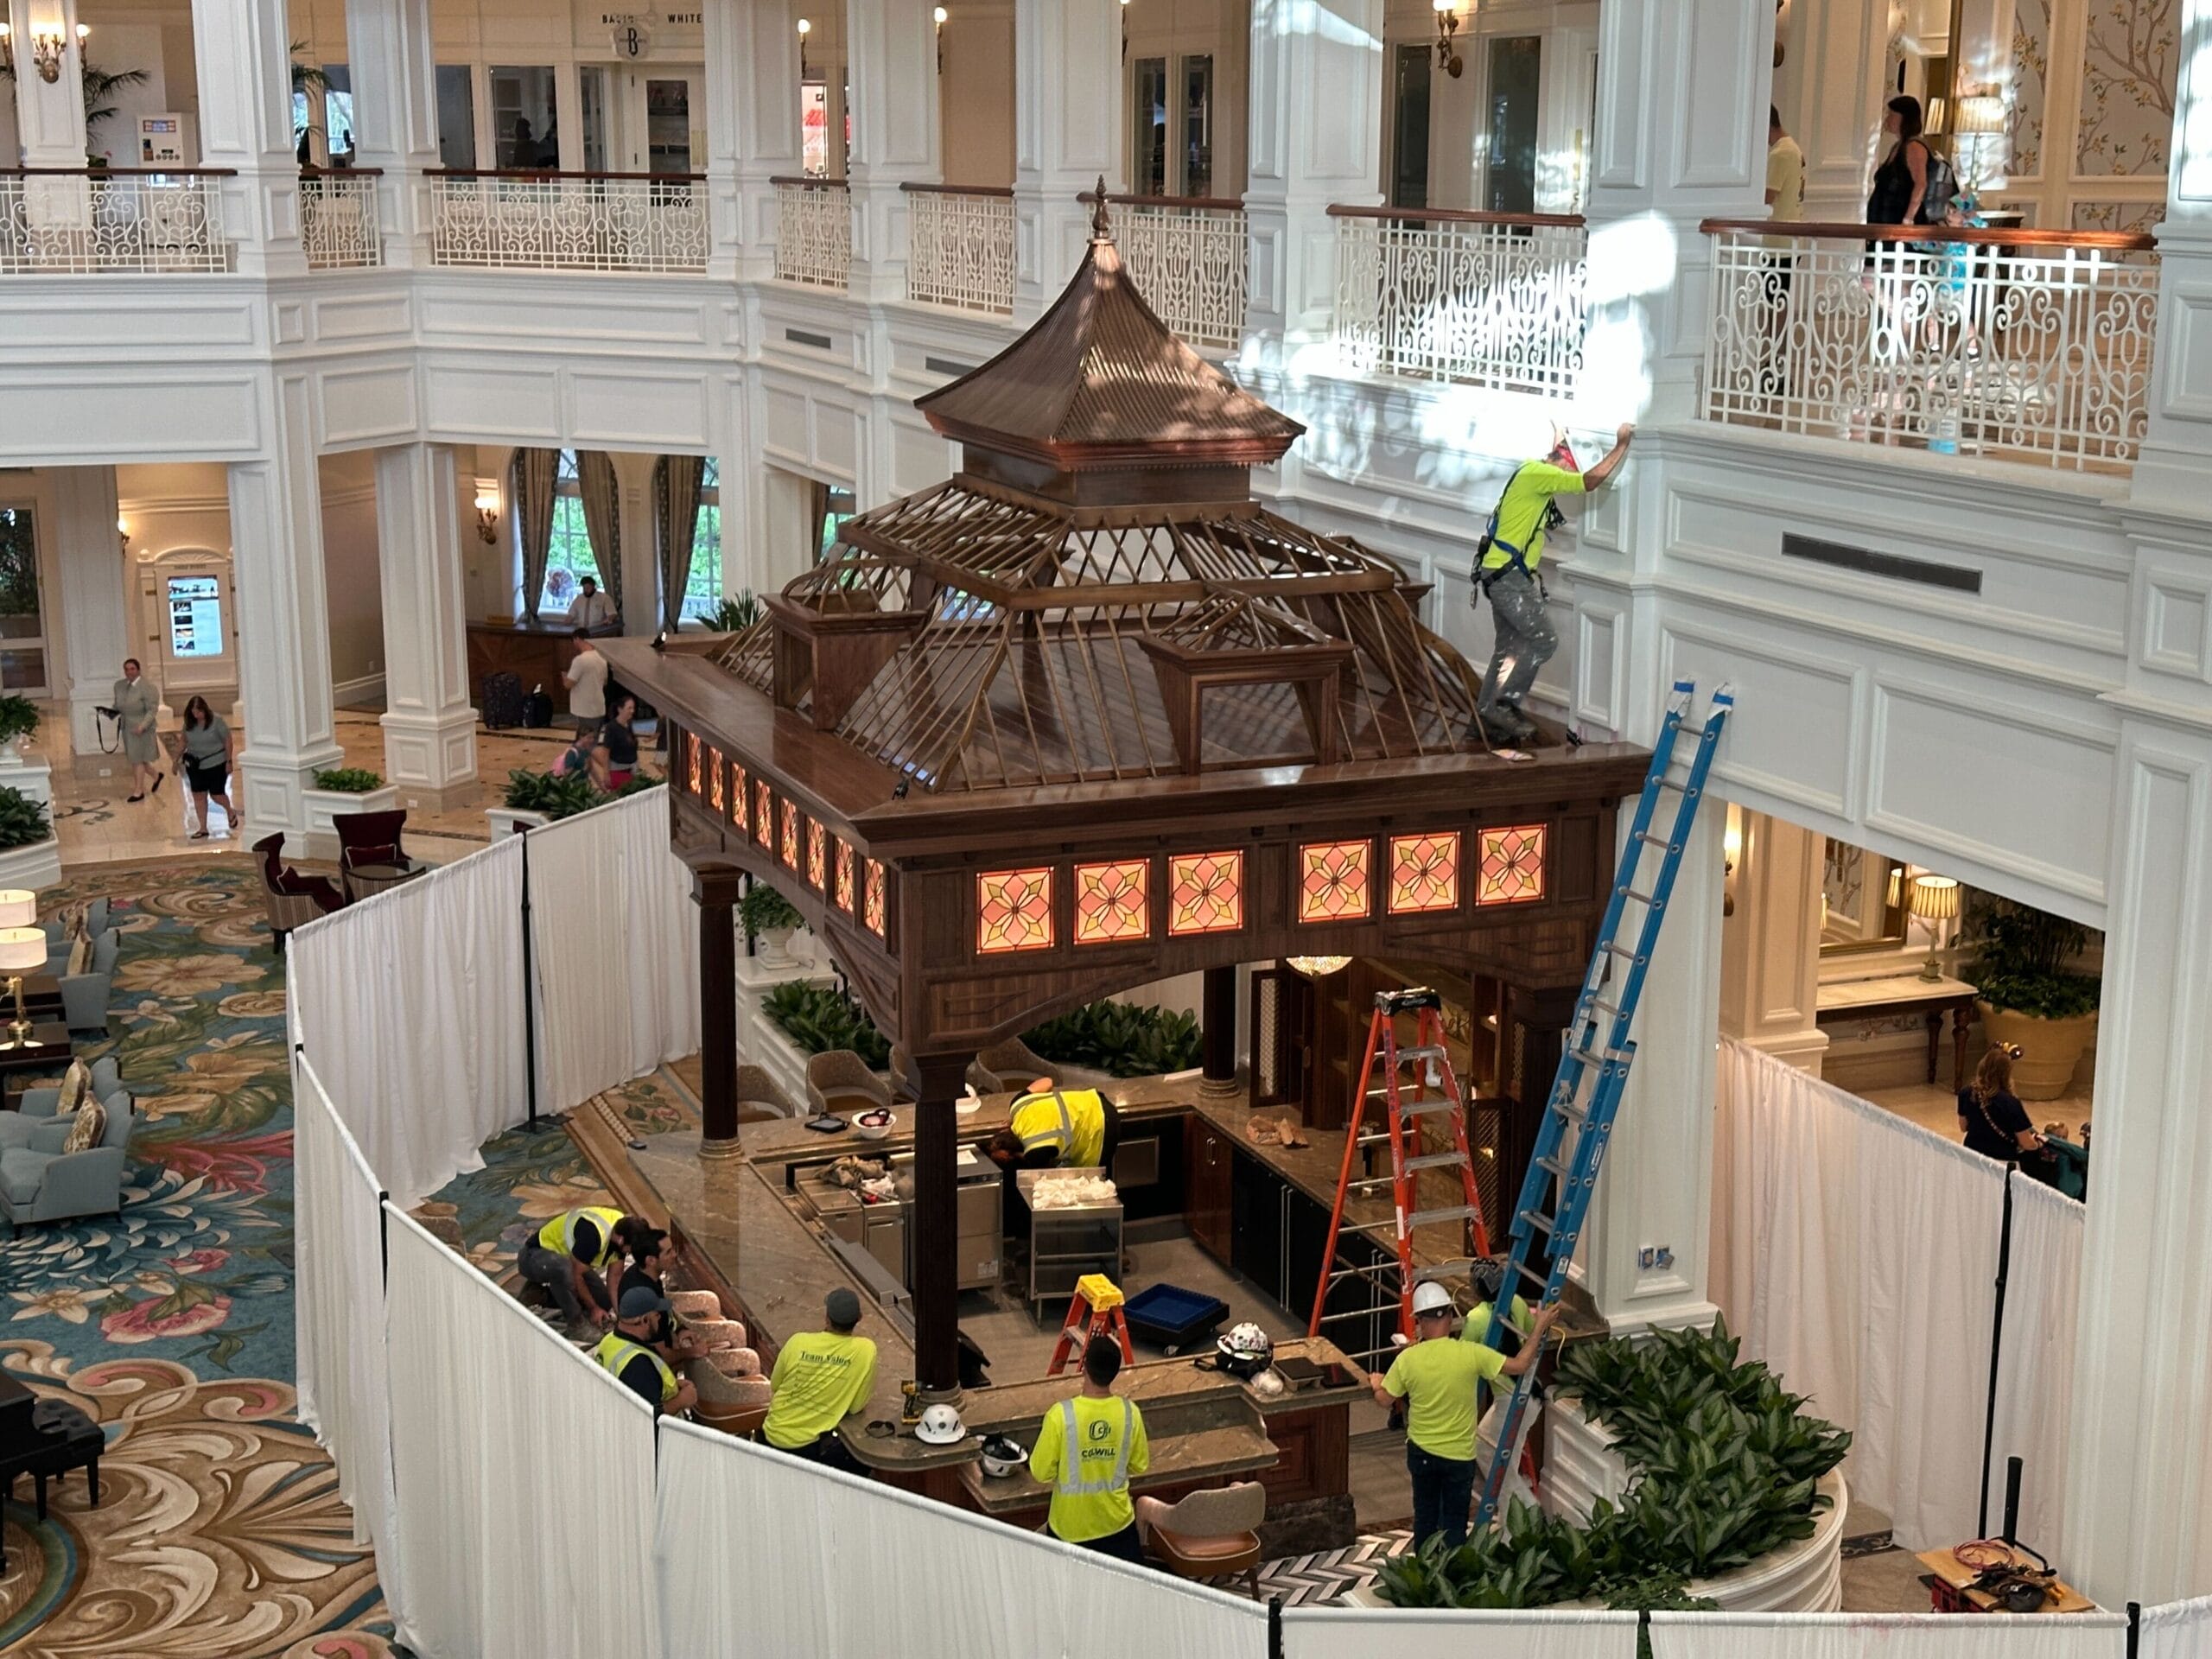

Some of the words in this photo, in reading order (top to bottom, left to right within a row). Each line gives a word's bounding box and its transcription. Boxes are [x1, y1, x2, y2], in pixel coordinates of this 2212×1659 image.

[667, 14, 702, 23] WHITE
[627, 27, 639, 56] B
[801, 1351, 823, 1363] Team
